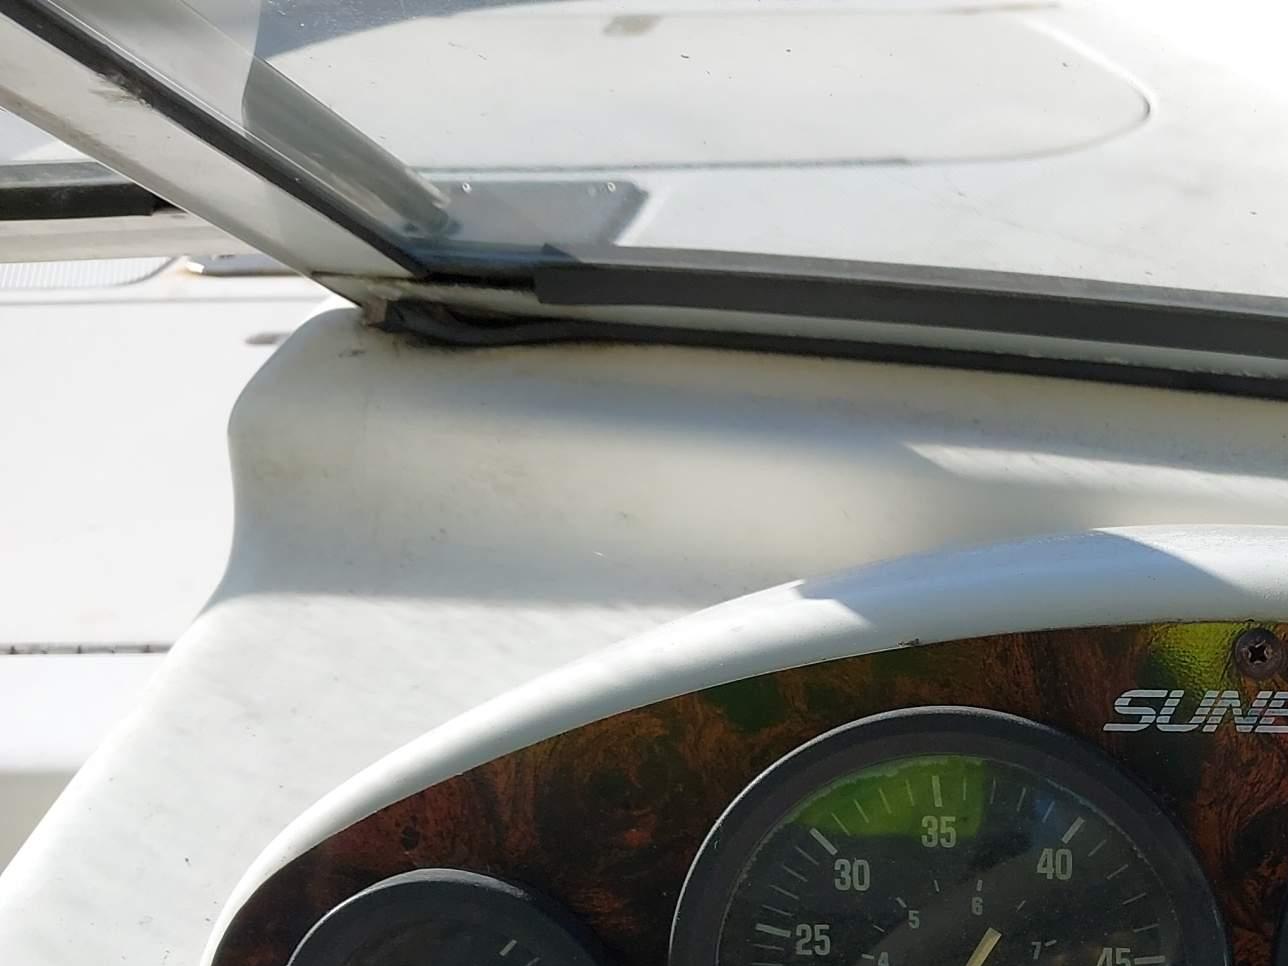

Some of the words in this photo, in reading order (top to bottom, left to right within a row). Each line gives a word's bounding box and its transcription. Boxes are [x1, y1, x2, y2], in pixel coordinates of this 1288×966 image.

[921, 816, 956, 848] 35
[834, 858, 870, 891] 30
[1037, 848, 1073, 880] 40
[796, 924, 831, 956] 25
